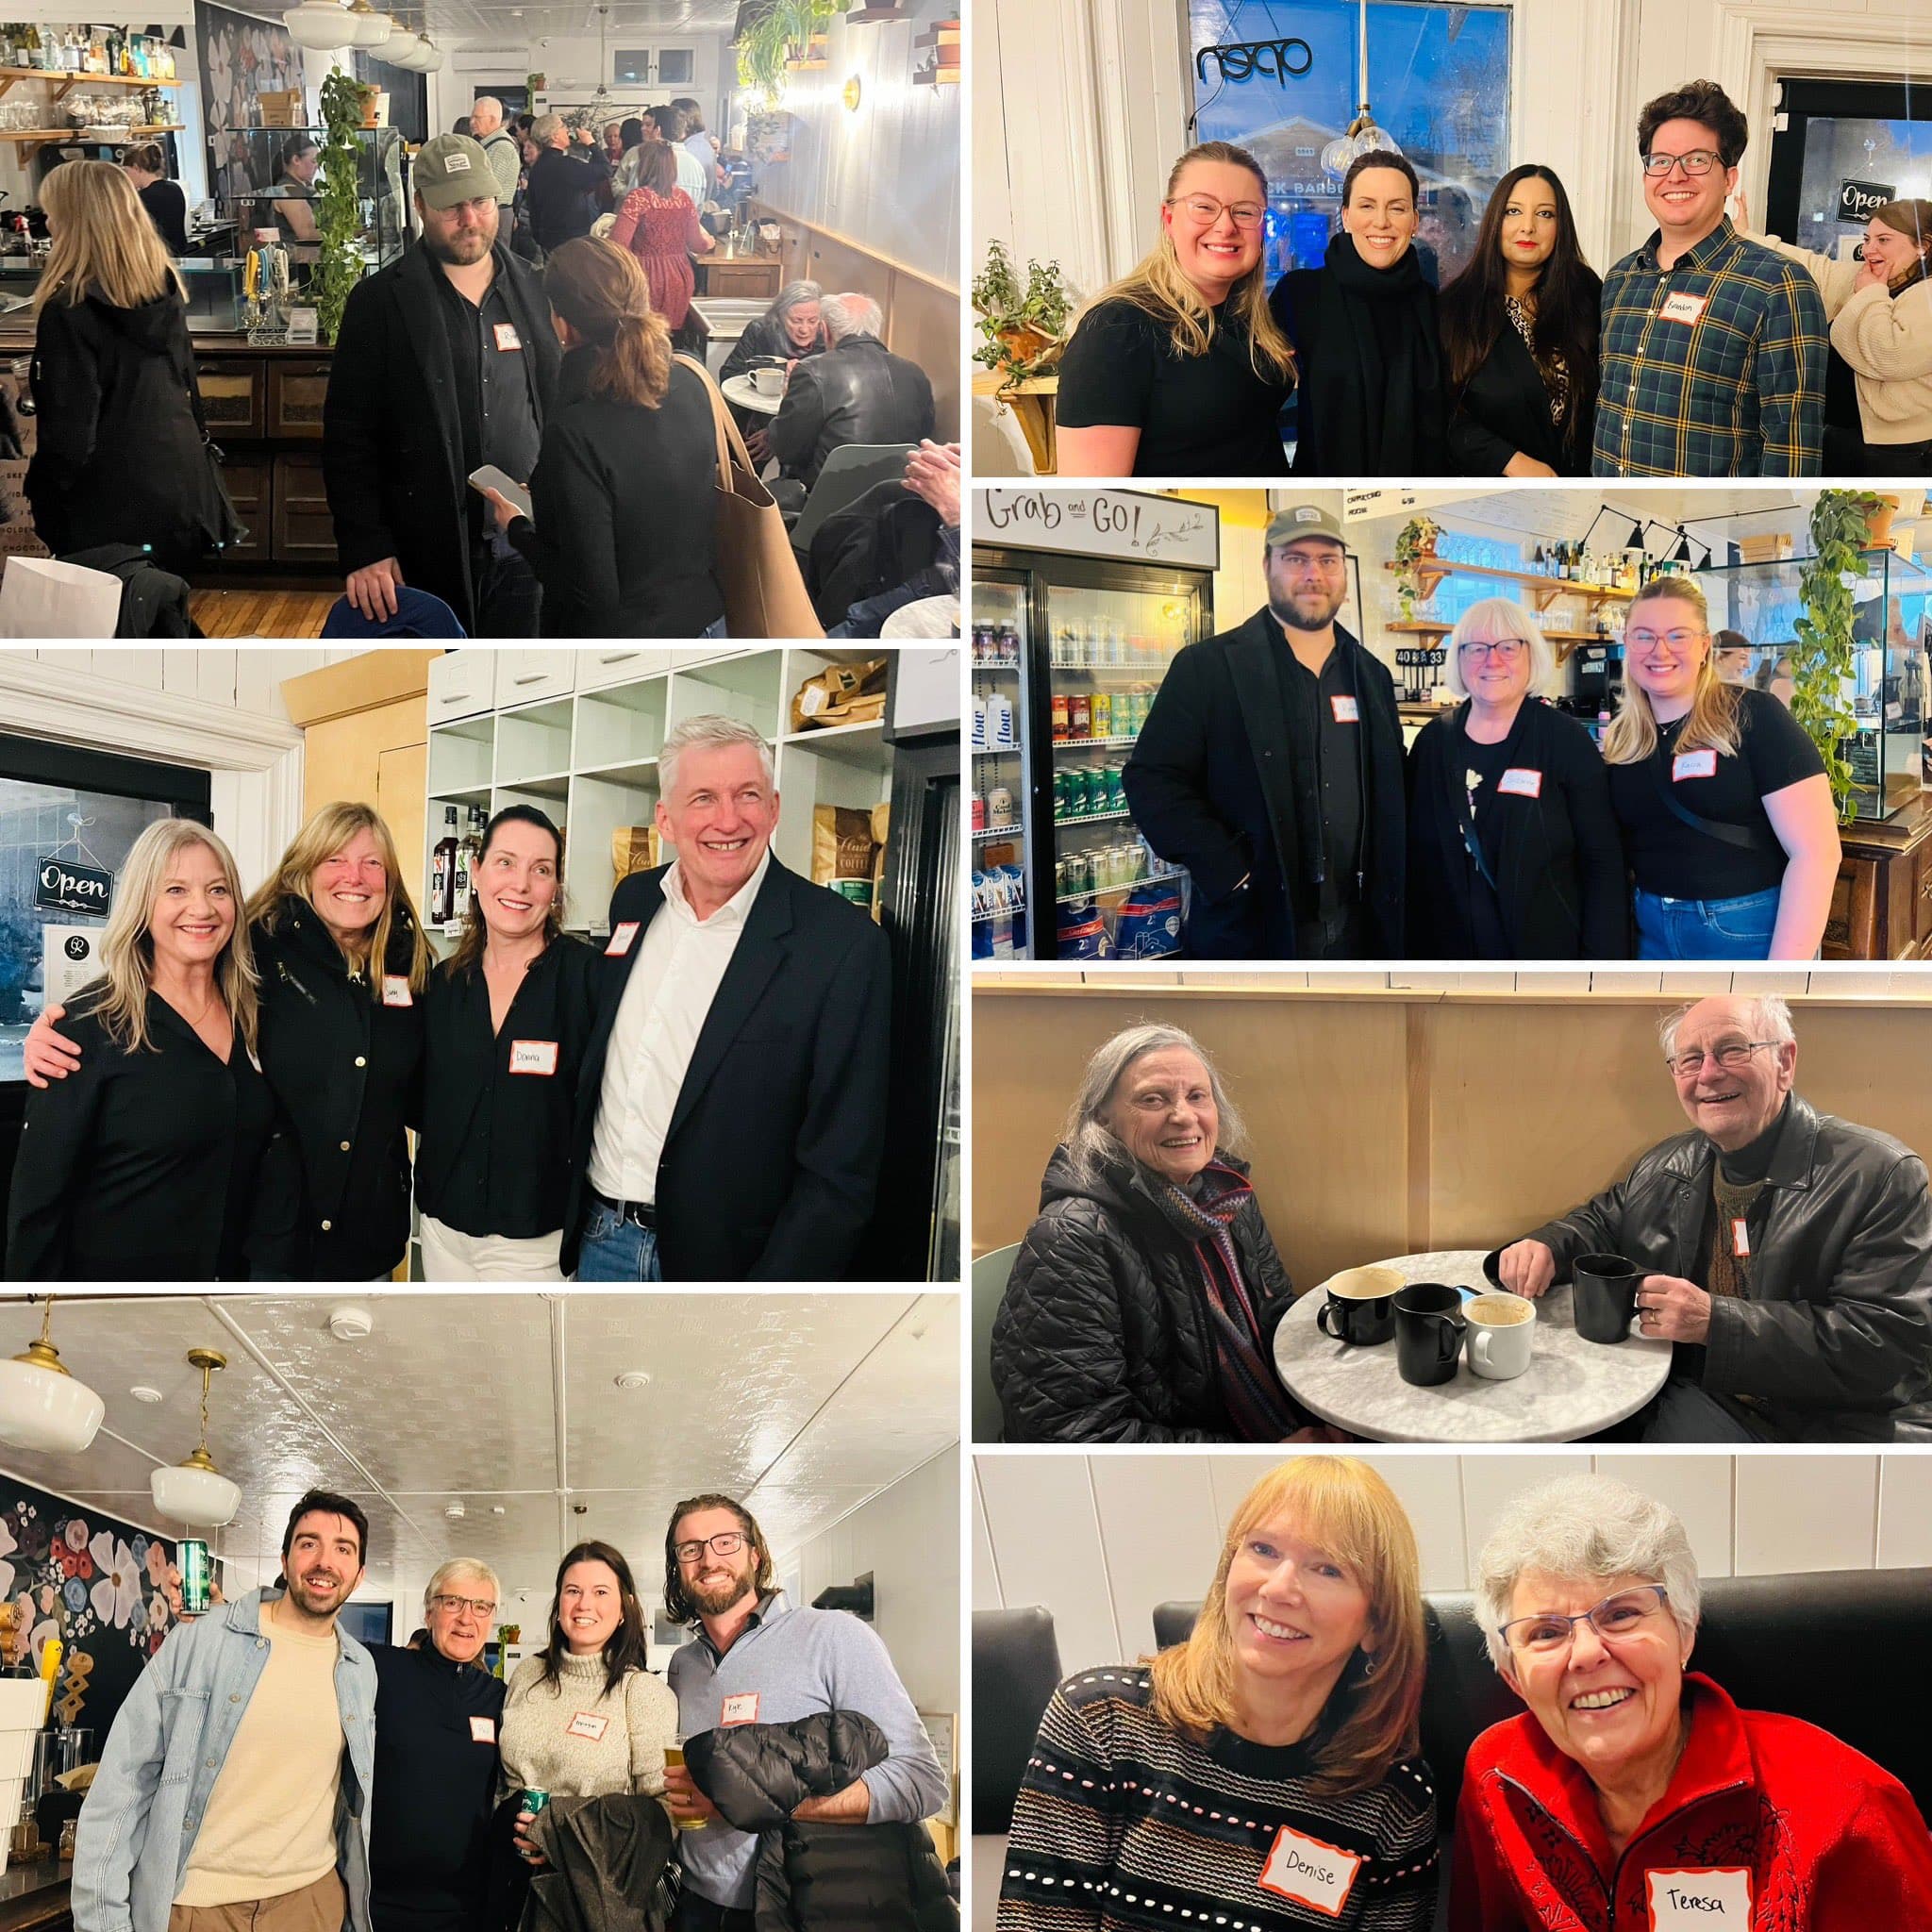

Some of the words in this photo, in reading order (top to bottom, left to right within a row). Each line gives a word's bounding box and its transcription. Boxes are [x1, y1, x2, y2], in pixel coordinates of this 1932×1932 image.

[1293, 182, 1343, 194] BARBE
[1842, 186, 1887, 212] Open
[986, 488, 1061, 529] Grab
[1068, 500, 1086, 512] and
[1397, 651, 1410, 663] 40
[1429, 651, 1442, 664] 33
[972, 710, 985, 745] flow
[997, 709, 1011, 743] flow
[41, 865, 108, 898] Open
[1287, 1851, 1335, 1885] Denise
[1667, 1889, 1725, 1914] Teresa
